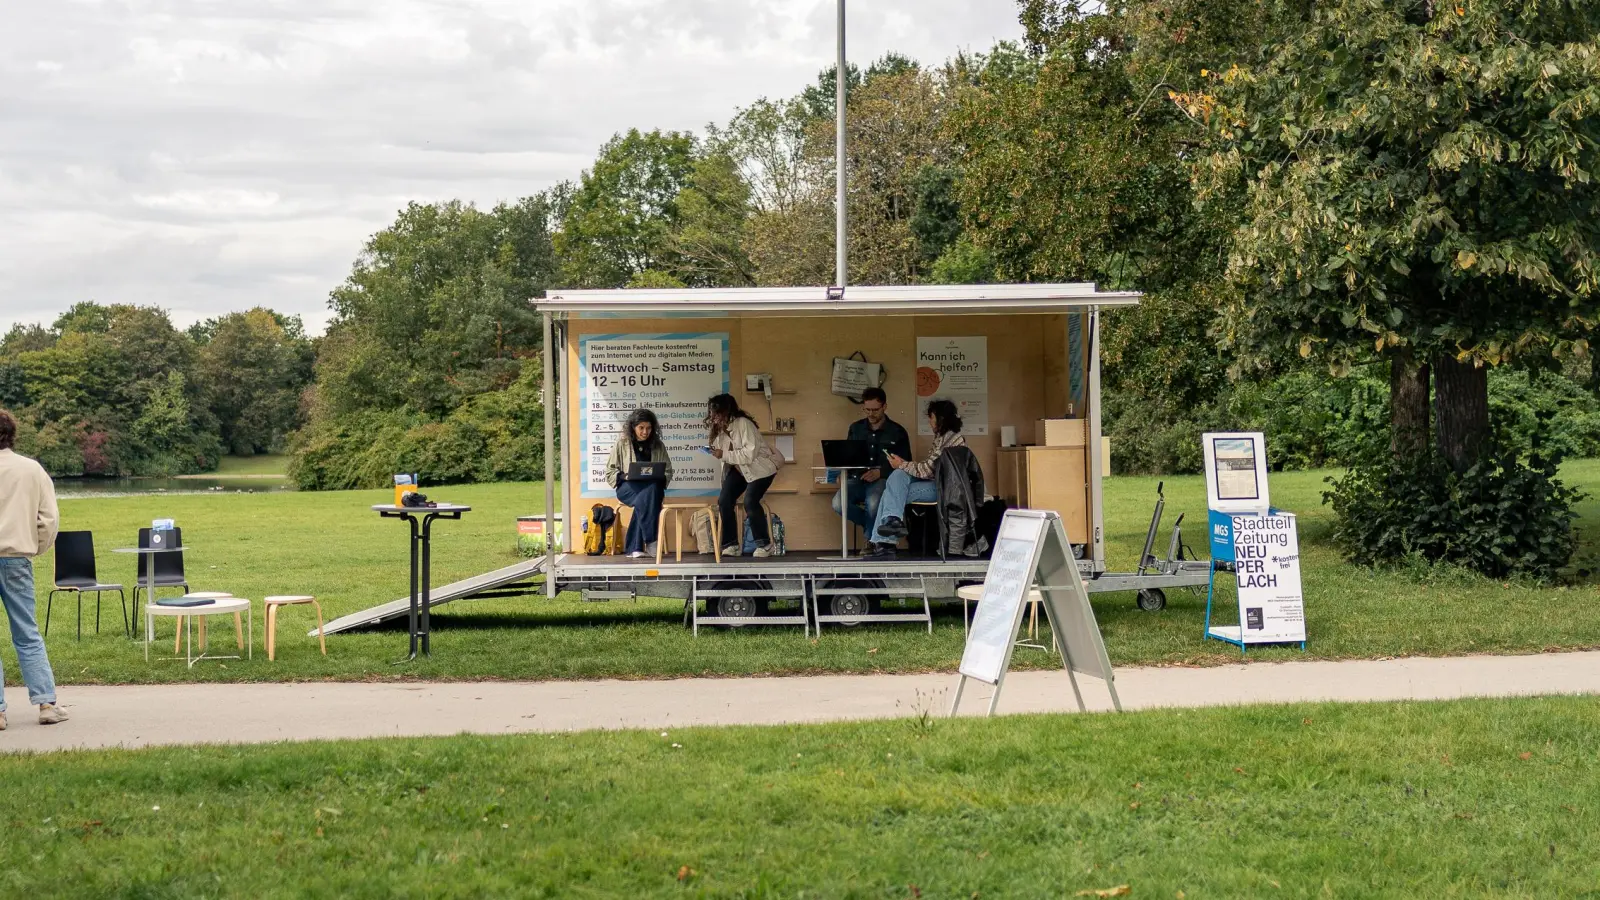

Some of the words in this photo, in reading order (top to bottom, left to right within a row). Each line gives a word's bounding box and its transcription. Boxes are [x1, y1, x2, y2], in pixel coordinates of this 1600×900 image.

[658, 351, 687, 359] digitalen
[920, 351, 947, 361] Kann
[949, 352, 965, 361] ich
[591, 363, 648, 373] Mittwoch
[662, 362, 715, 373] Samstag
[940, 362, 979, 372] helfen?
[592, 376, 607, 387] 12
[620, 375, 636, 387] 16
[640, 375, 666, 386] Uhr
[622, 391, 637, 399] Sep
[640, 390, 670, 399] Ostpark
[622, 402, 637, 410] Sep
[1232, 516, 1291, 530] Stadtteil
[1214, 523, 1229, 537] MGS
[1234, 531, 1288, 546] Zeitung
[1235, 545, 1267, 559] NEU
[1236, 560, 1265, 573] PER
[1238, 574, 1277, 588] LACH
